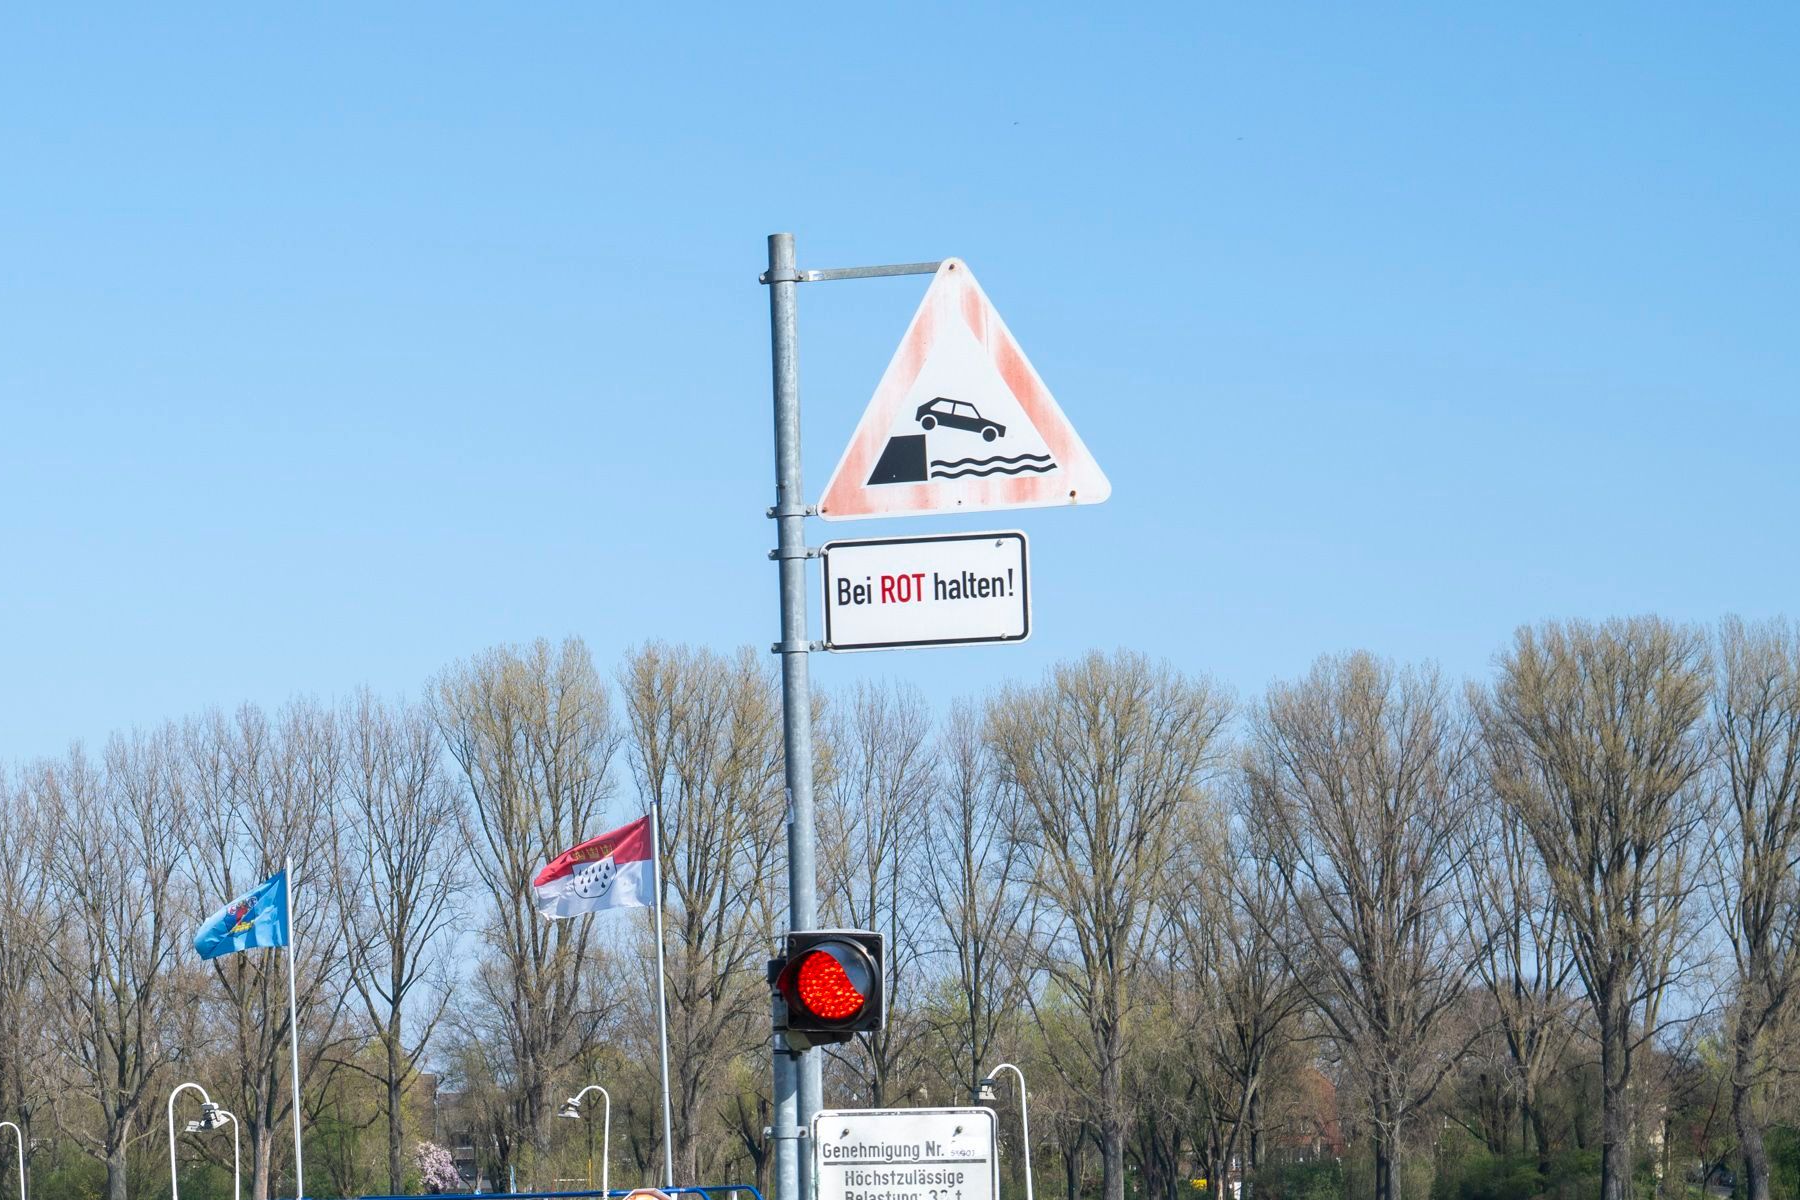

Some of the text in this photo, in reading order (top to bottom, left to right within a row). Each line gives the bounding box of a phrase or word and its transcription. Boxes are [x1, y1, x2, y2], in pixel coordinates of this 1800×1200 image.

[837, 568, 1014, 606] Bei ROT halten!
[822, 1142, 920, 1161] Genehmigung
[925, 1140, 945, 1158] Nr.
[845, 1169, 964, 1188] Höchstzulässige
